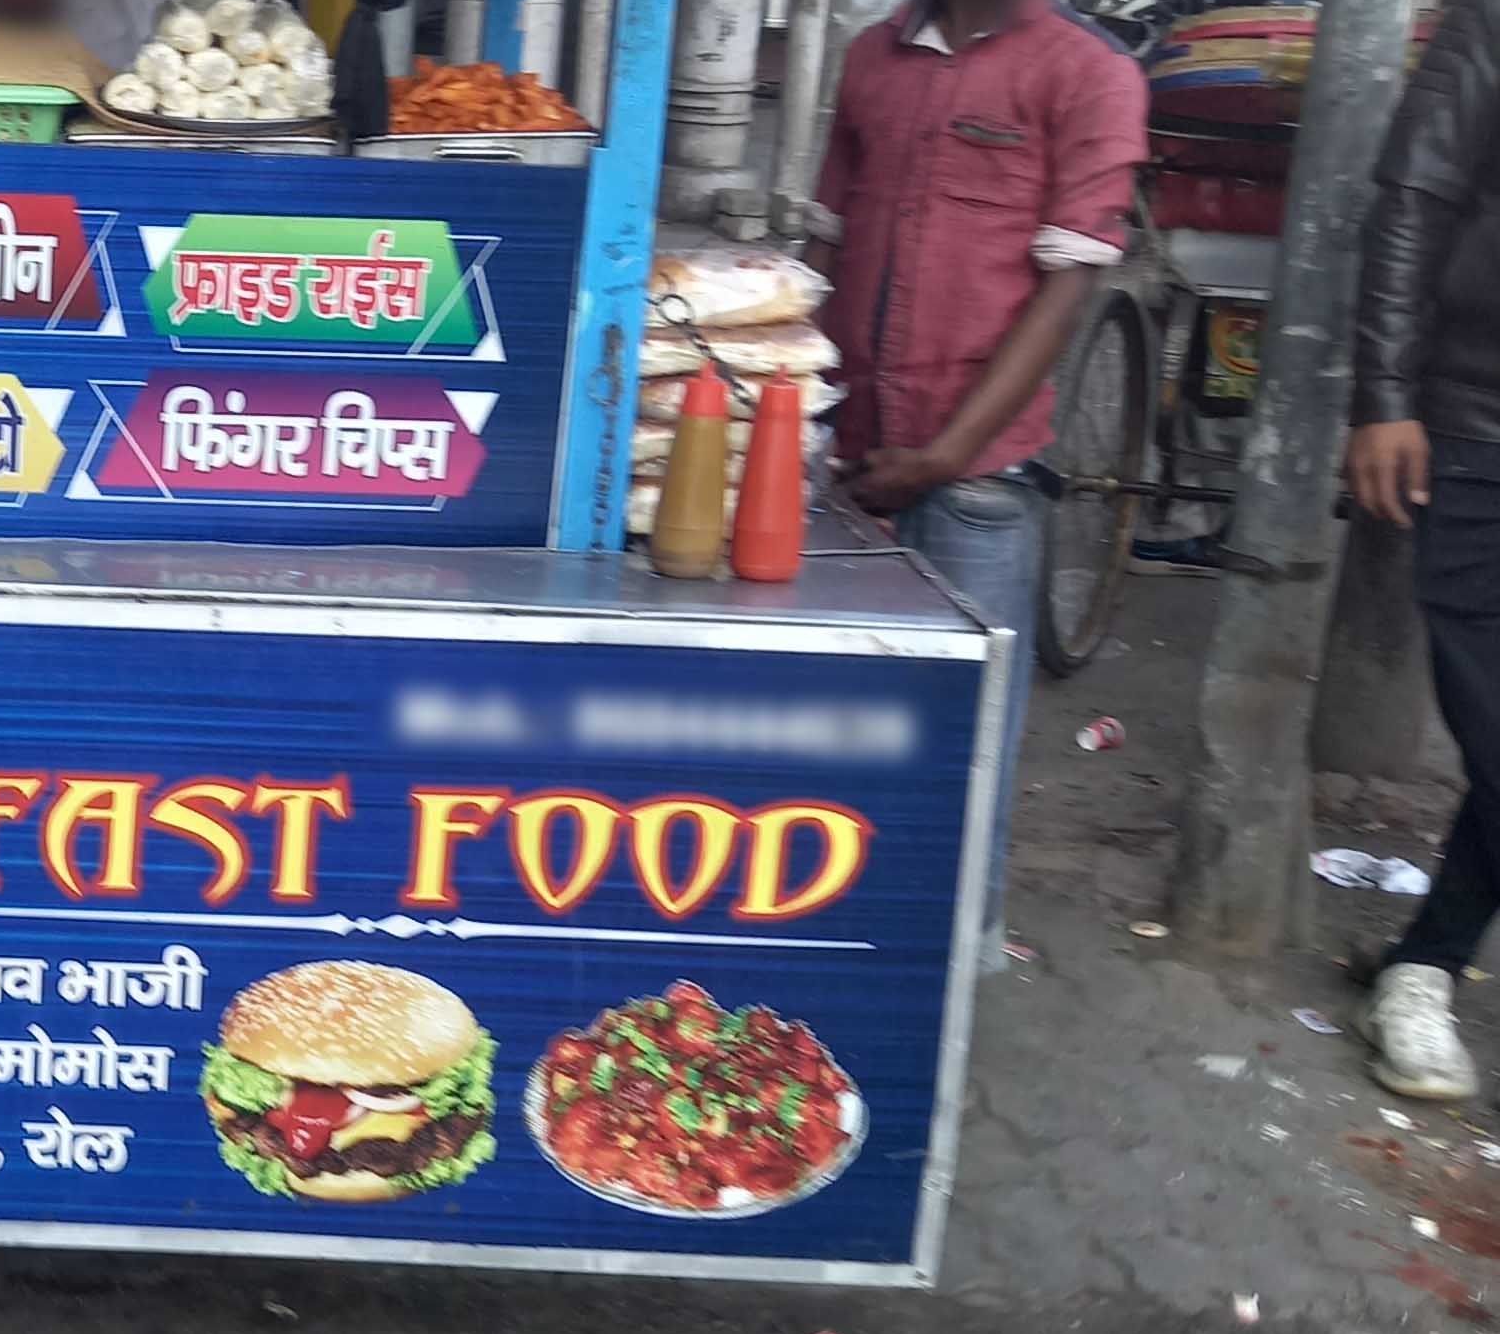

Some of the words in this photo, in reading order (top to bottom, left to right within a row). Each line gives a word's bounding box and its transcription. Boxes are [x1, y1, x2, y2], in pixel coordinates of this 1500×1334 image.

[168, 249, 308, 328] फ्राइड
[308, 229, 434, 330] राईस
[159, 386, 318, 480] फिंगर
[320, 386, 456, 484] चिप्स
[400, 785, 876, 920] FOOD
[58, 944, 209, 1011] भाजी
[21, 1106, 134, 1172] रोल
